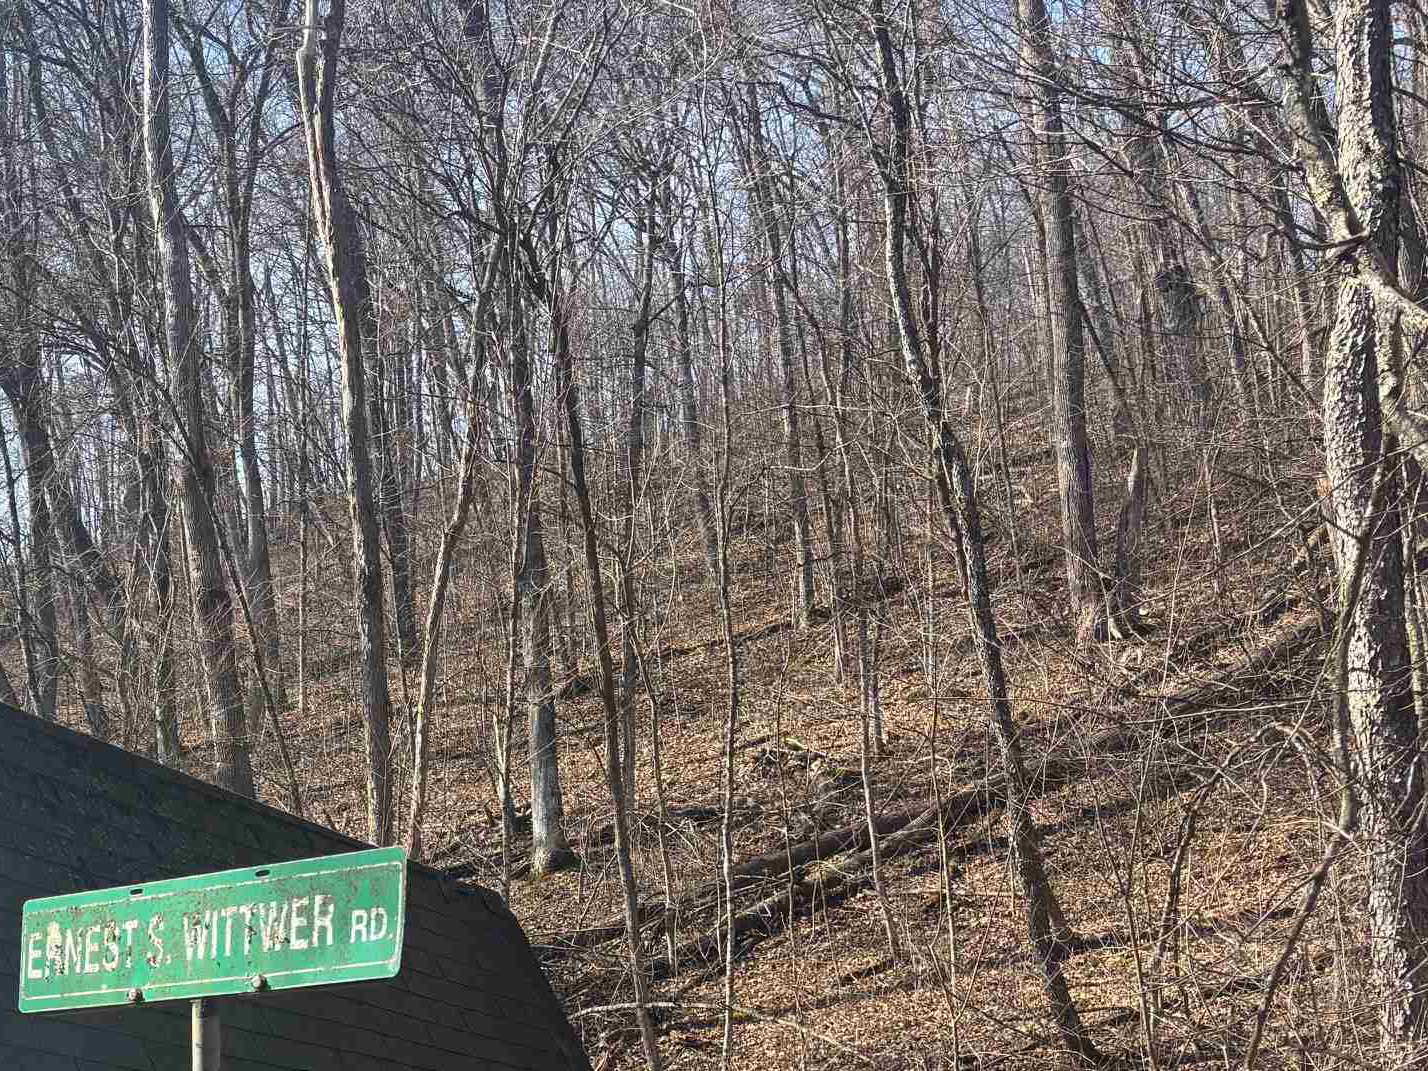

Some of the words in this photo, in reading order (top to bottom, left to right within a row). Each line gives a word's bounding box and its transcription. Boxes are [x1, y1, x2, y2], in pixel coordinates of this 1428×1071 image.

[27, 920, 139, 980] ERNEST
[183, 894, 334, 960] WITTWER
[349, 907, 394, 944] RD.
